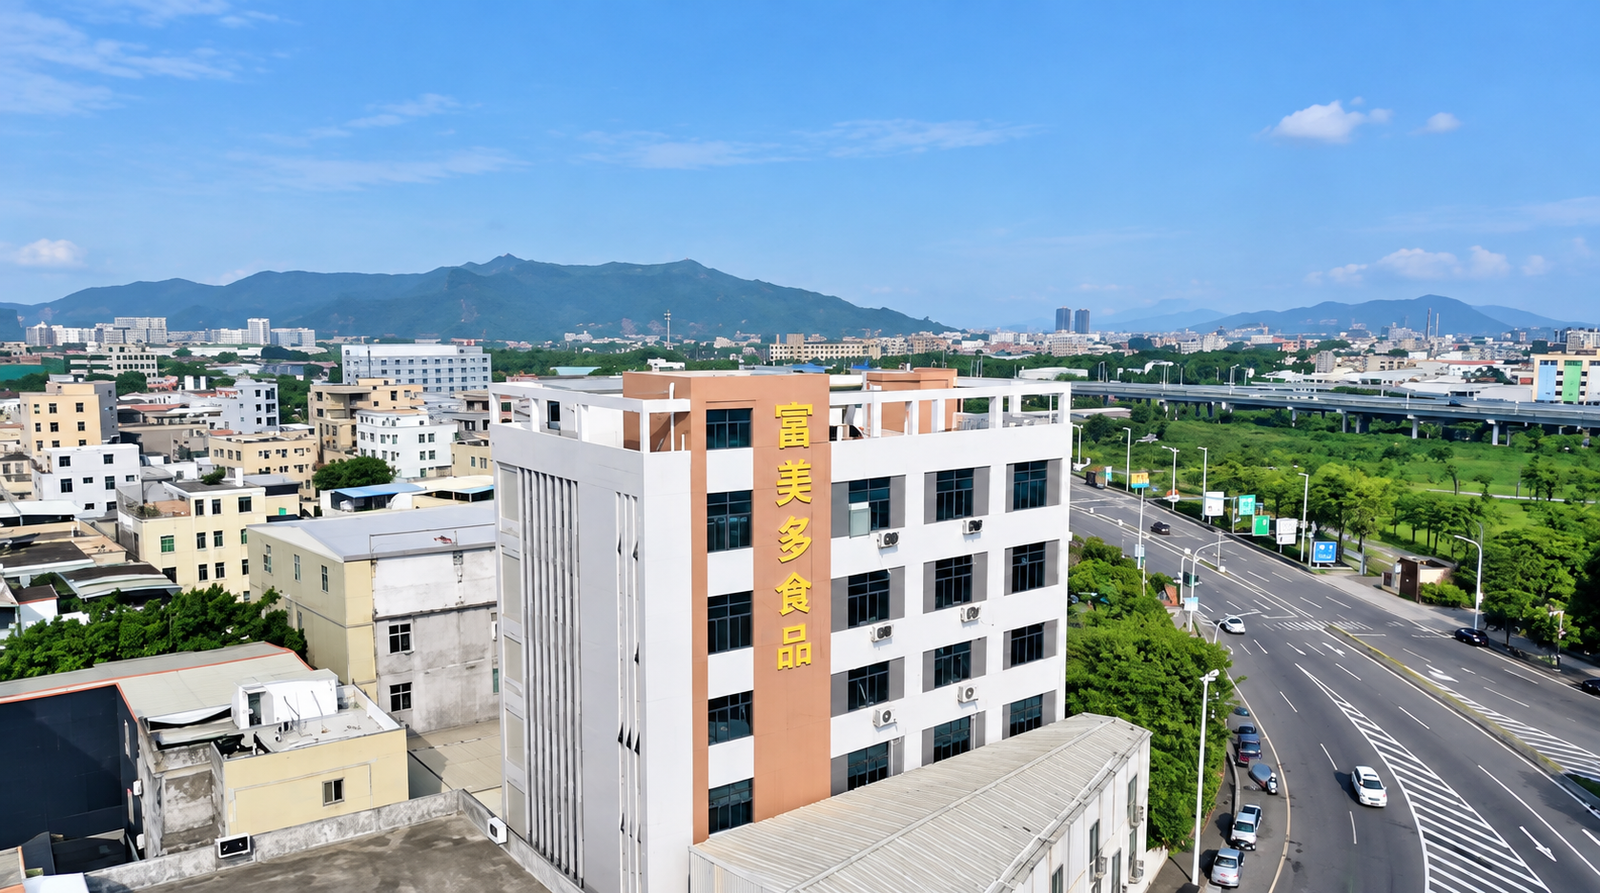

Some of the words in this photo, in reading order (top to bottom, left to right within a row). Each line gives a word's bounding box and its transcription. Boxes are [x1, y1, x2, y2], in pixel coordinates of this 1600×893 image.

[775, 402, 813, 670] 富美多食品
